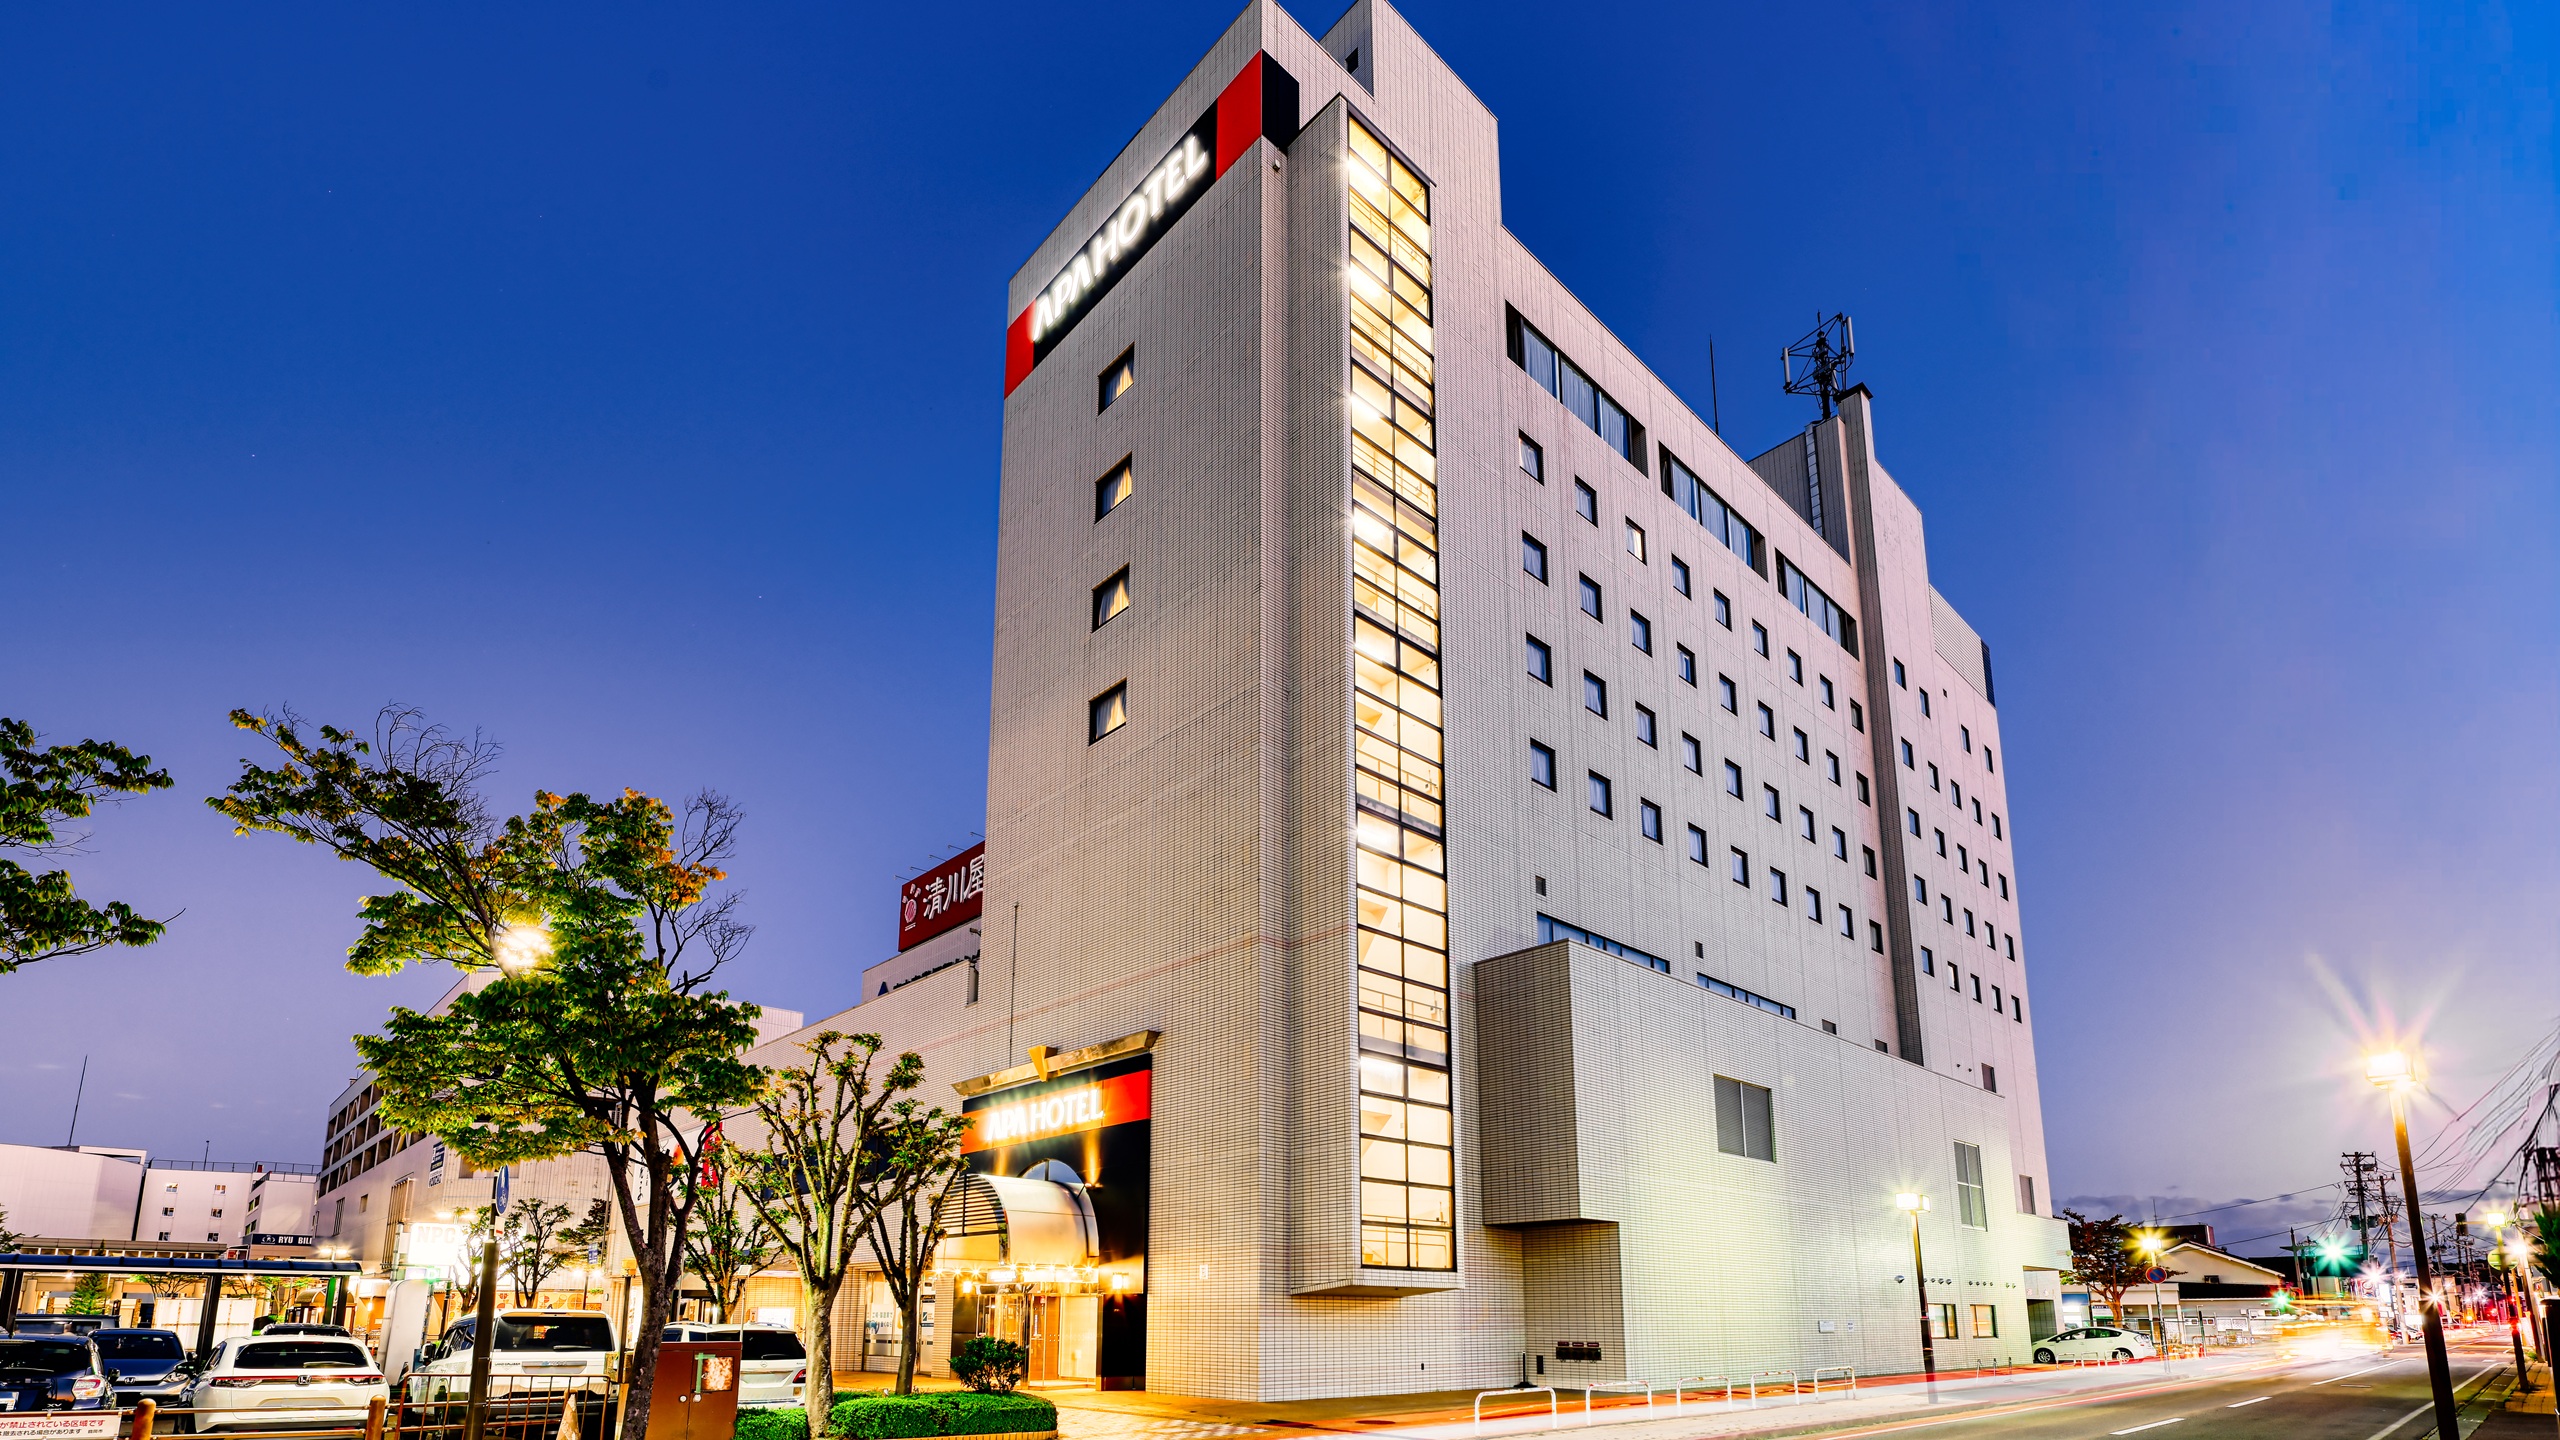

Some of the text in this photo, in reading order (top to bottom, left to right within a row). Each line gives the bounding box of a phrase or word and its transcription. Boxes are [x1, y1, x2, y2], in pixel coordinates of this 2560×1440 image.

[1032, 135, 1208, 341] APA HOTEL
[922, 854, 985, 920] 清川屋
[986, 1088, 1105, 1141] APA HOTEL
[278, 1236, 294, 1244] RYU
[417, 1226, 457, 1244] NPC
